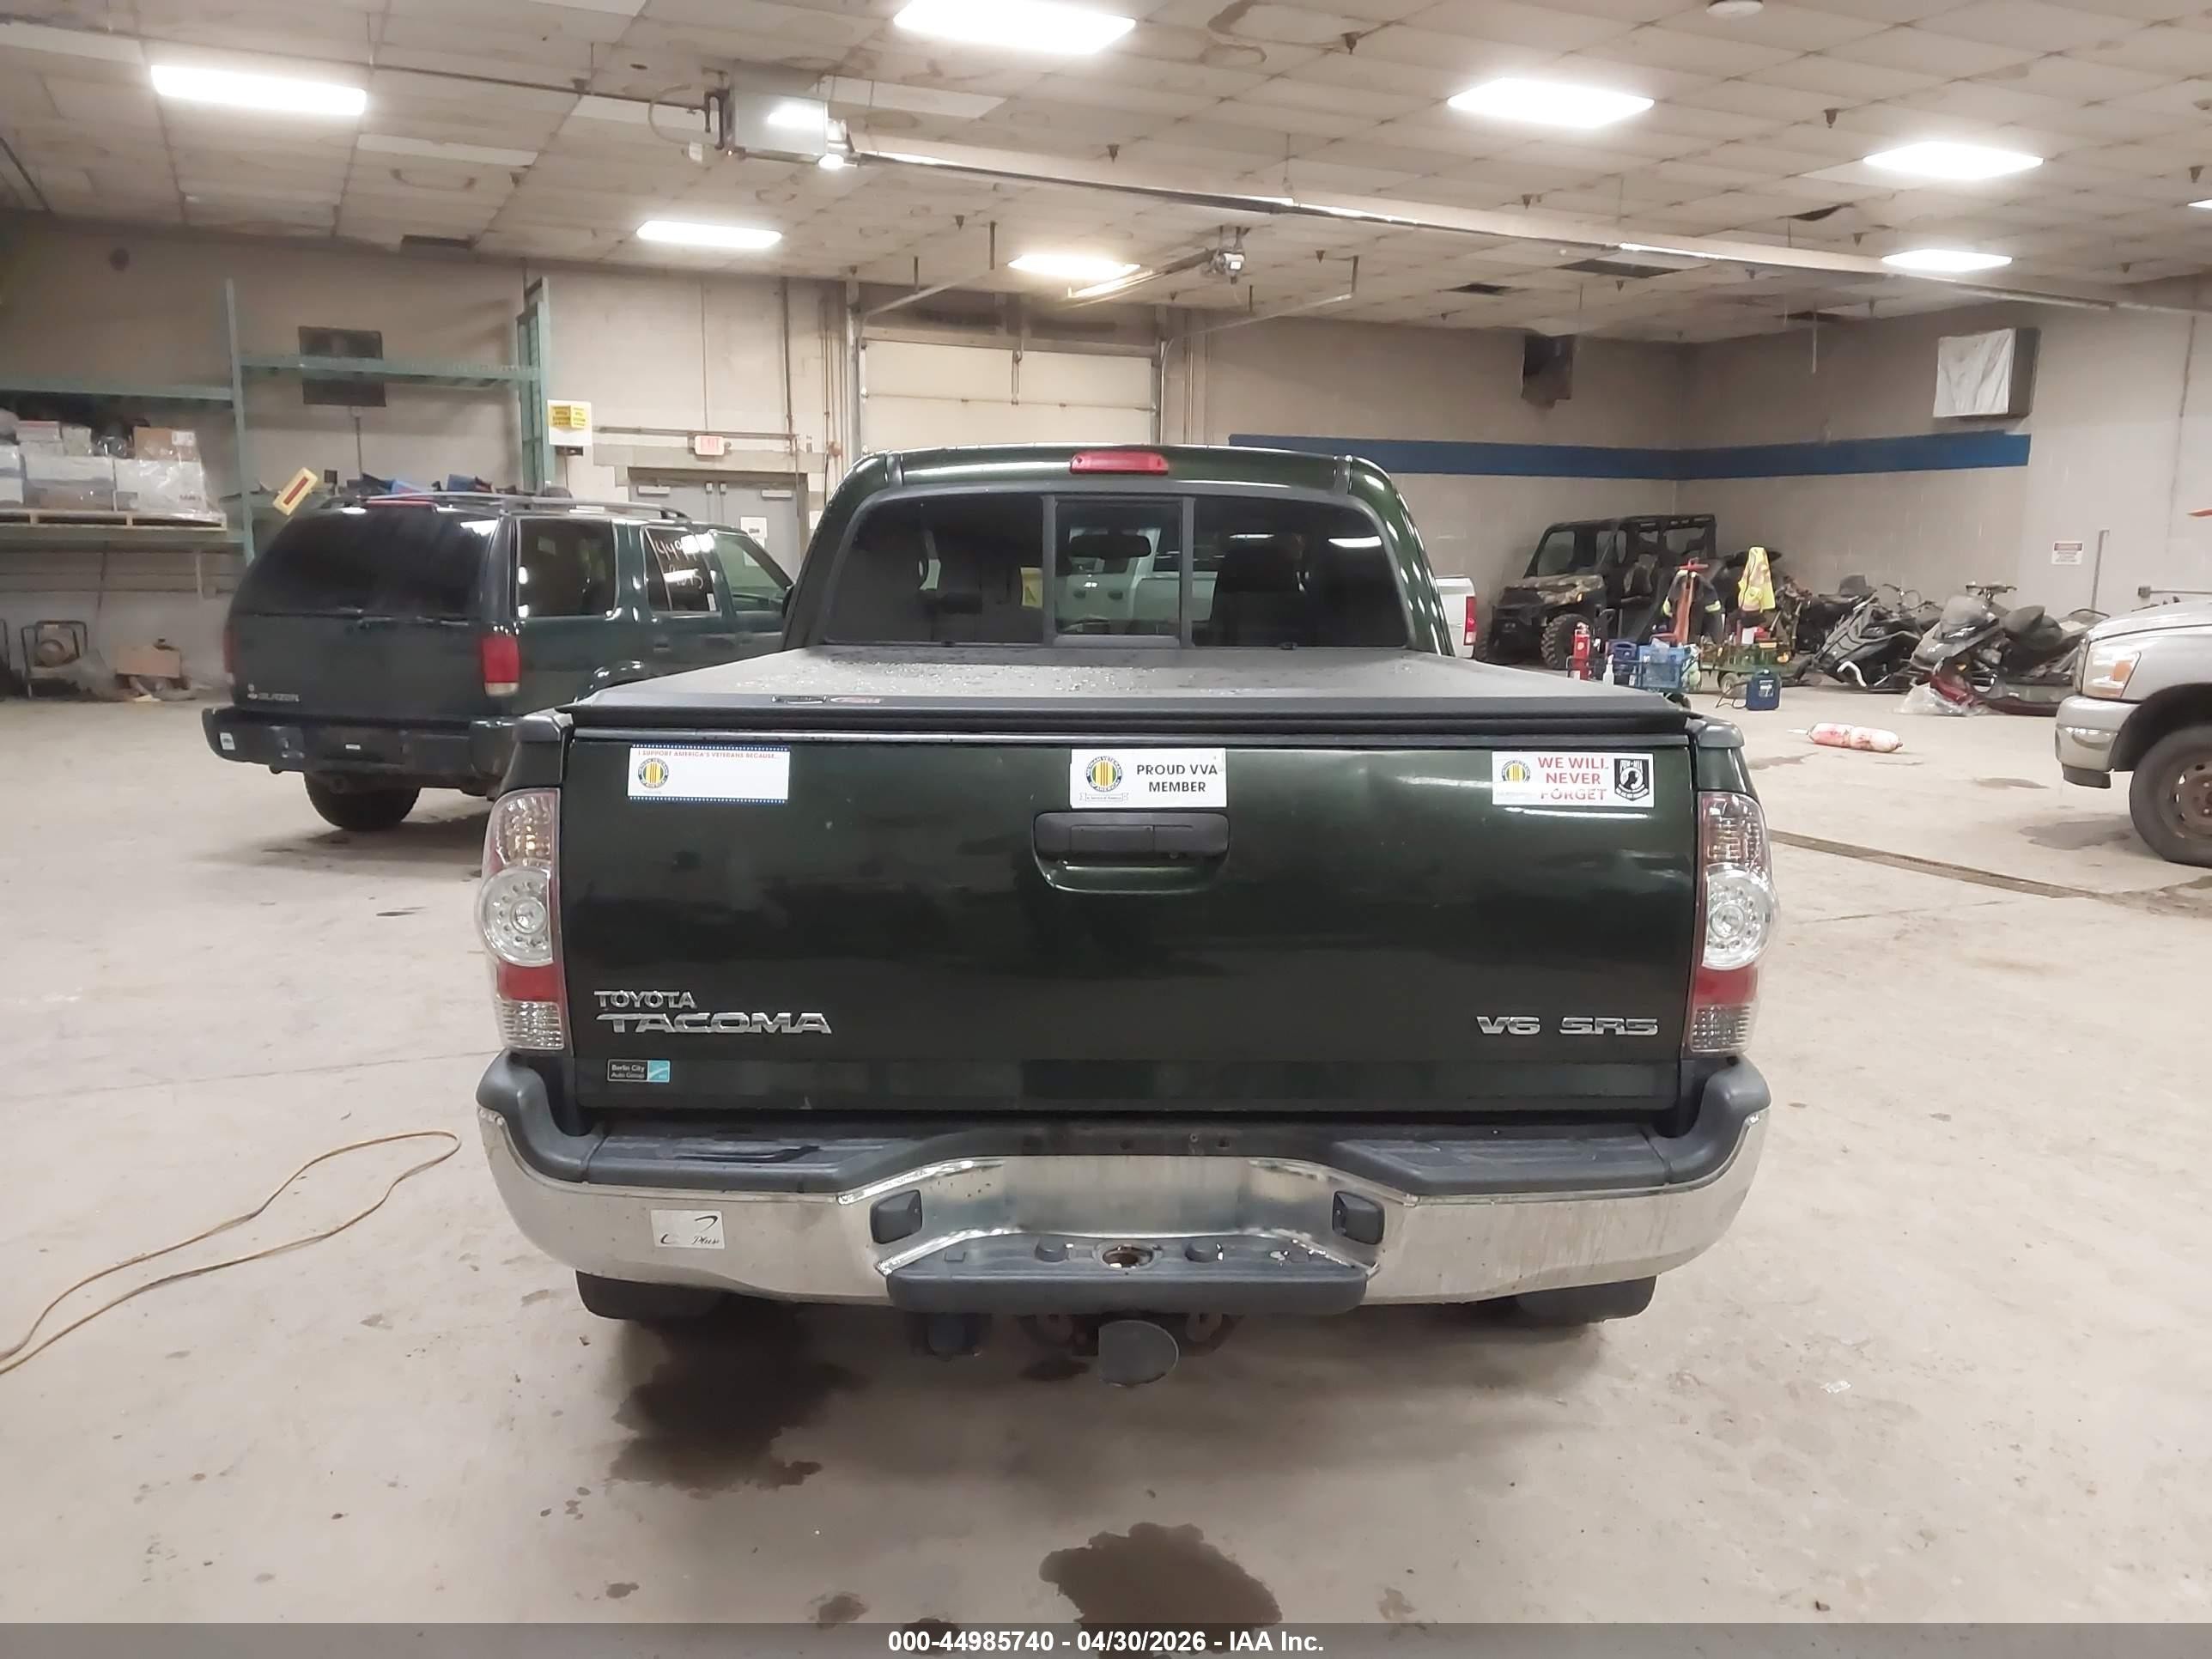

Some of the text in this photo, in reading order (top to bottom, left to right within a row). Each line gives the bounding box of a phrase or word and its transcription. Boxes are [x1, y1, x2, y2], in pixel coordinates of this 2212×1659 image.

[1538, 757, 1610, 769] WE WILL
[1137, 764, 1218, 775] PROUD VVA
[1546, 773, 1601, 785] NEVER
[1149, 781, 1206, 793] MEMBER
[1540, 788, 1607, 800] FORGET
[594, 990, 697, 1009] TOYOTA
[597, 1012, 832, 1034] TACOMA
[1476, 1016, 1658, 1036] V6 SR5
[631, 1064, 645, 1073] City
